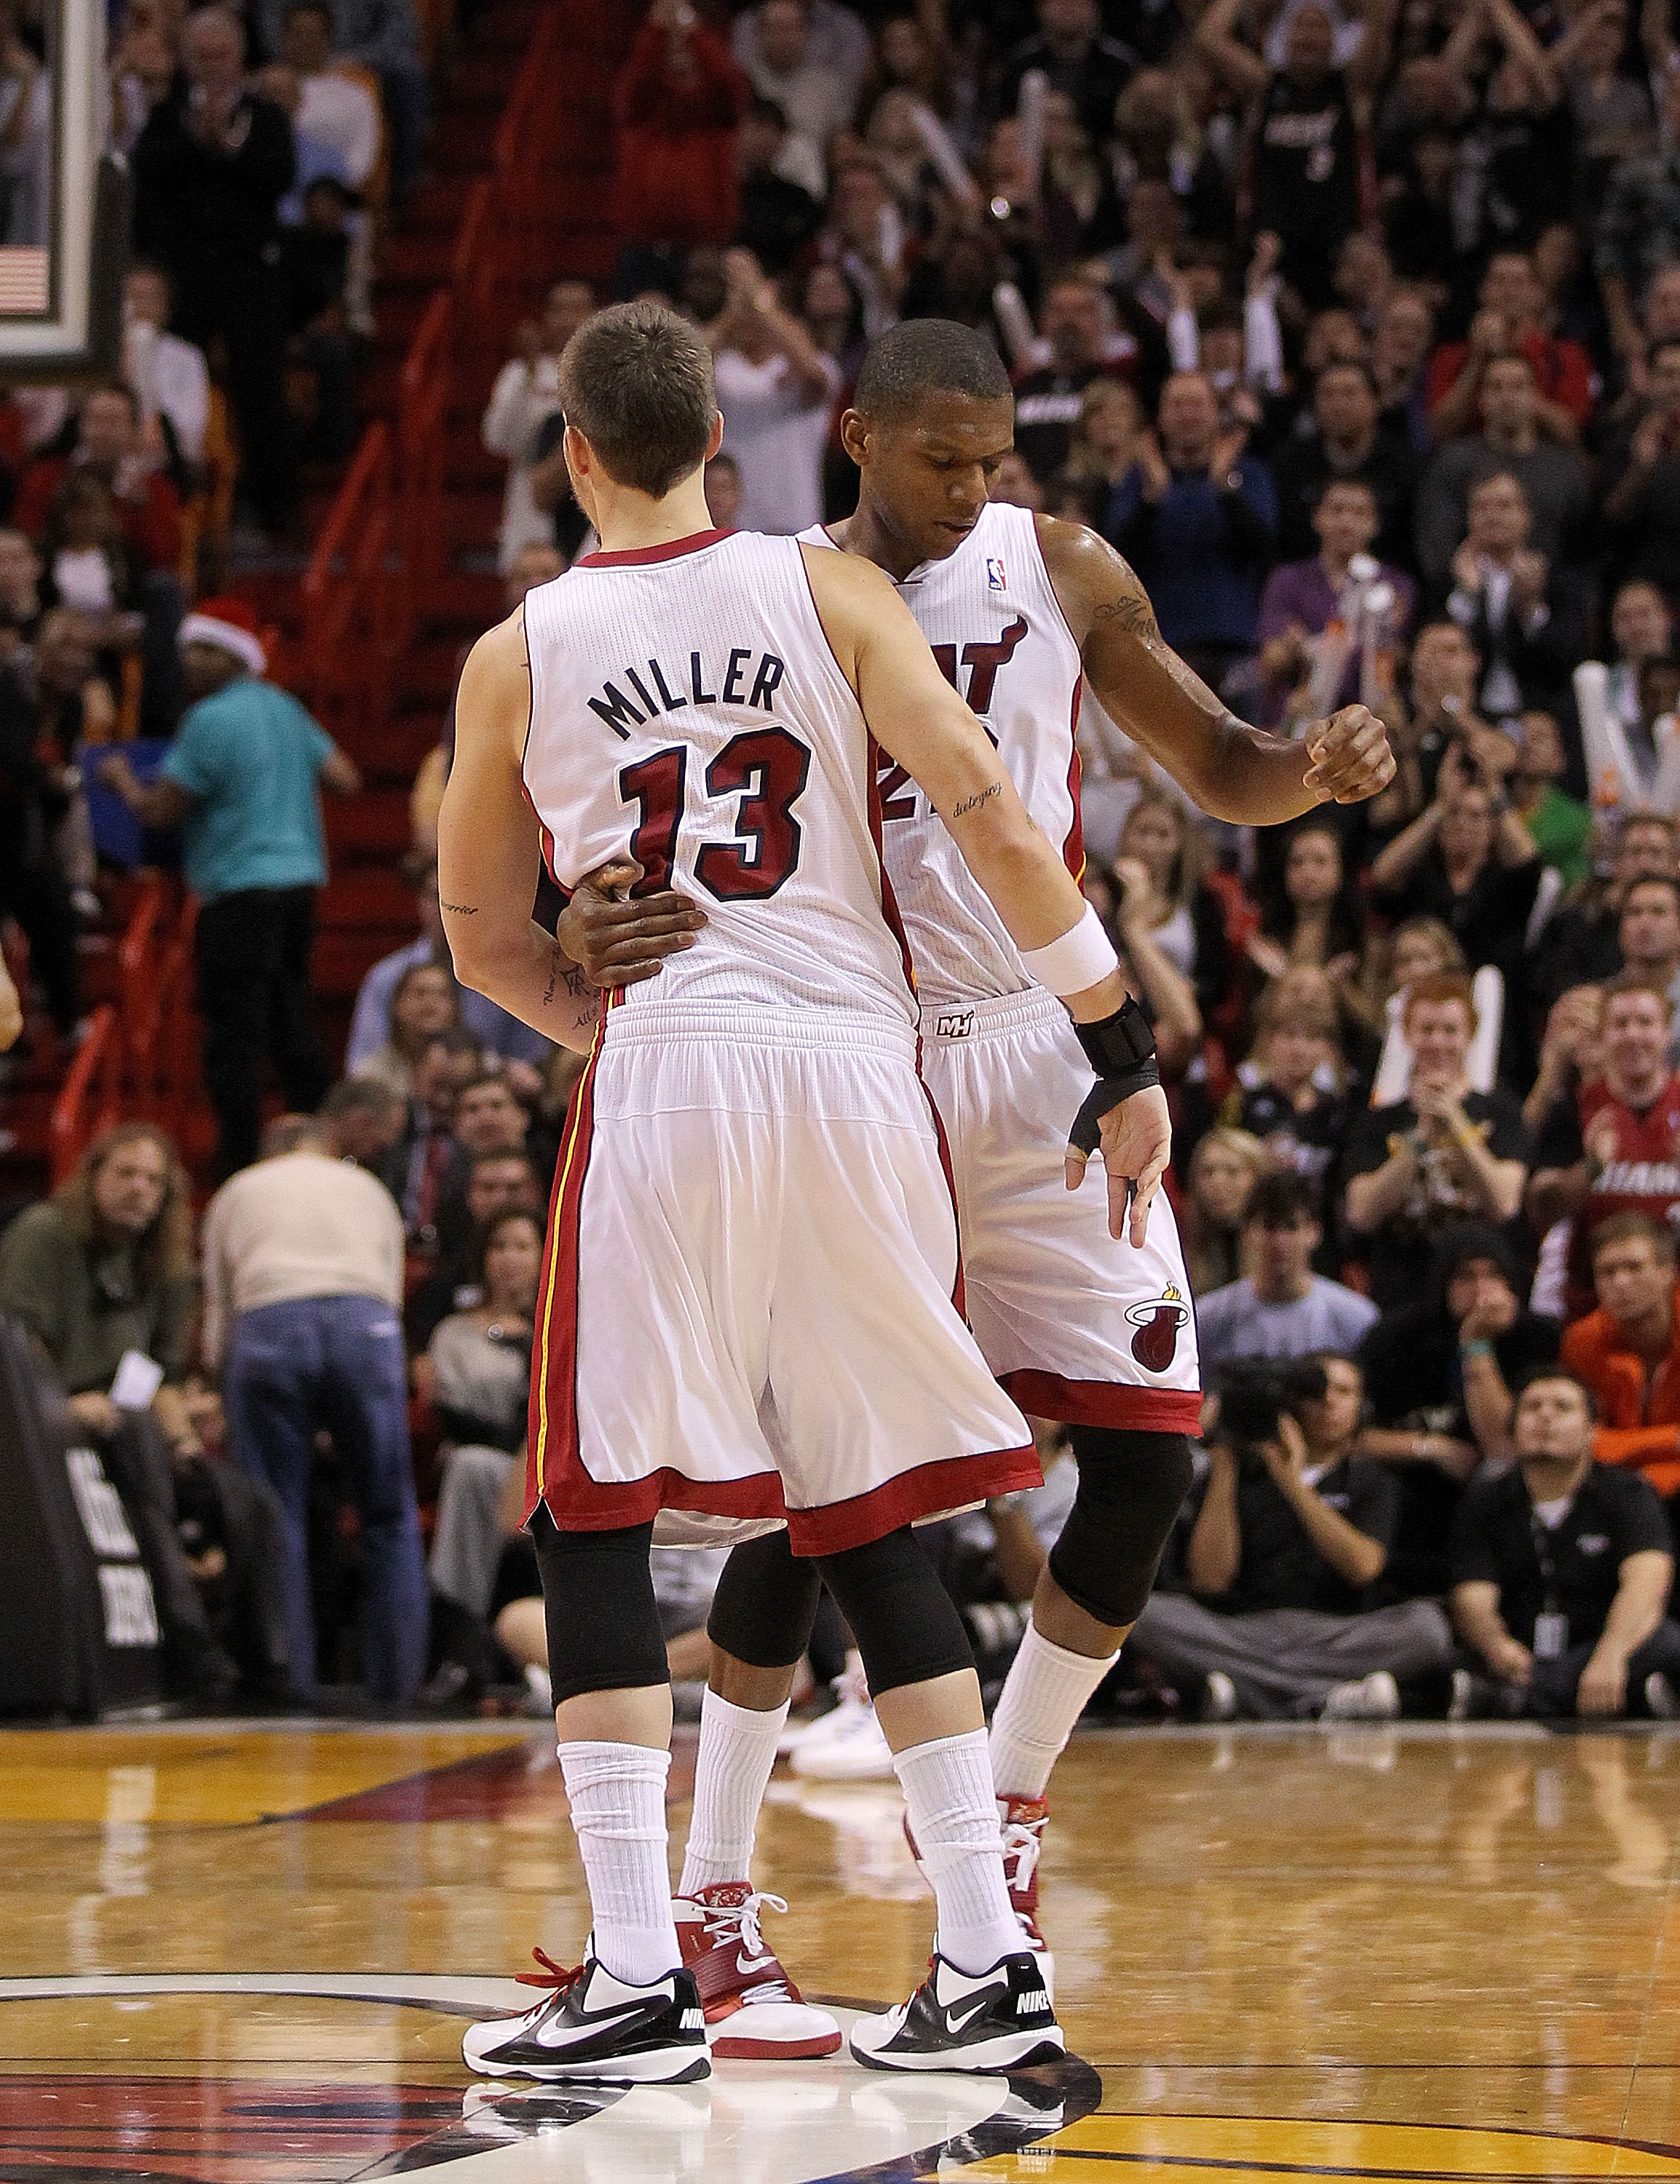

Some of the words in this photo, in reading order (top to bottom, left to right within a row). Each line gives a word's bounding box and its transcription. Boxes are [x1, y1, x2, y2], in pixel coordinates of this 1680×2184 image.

[587, 649, 784, 740] MILLER
[619, 727, 812, 902] 13
[678, 2008, 705, 2030] NIK
[1016, 1990, 1050, 2014] NIKE
